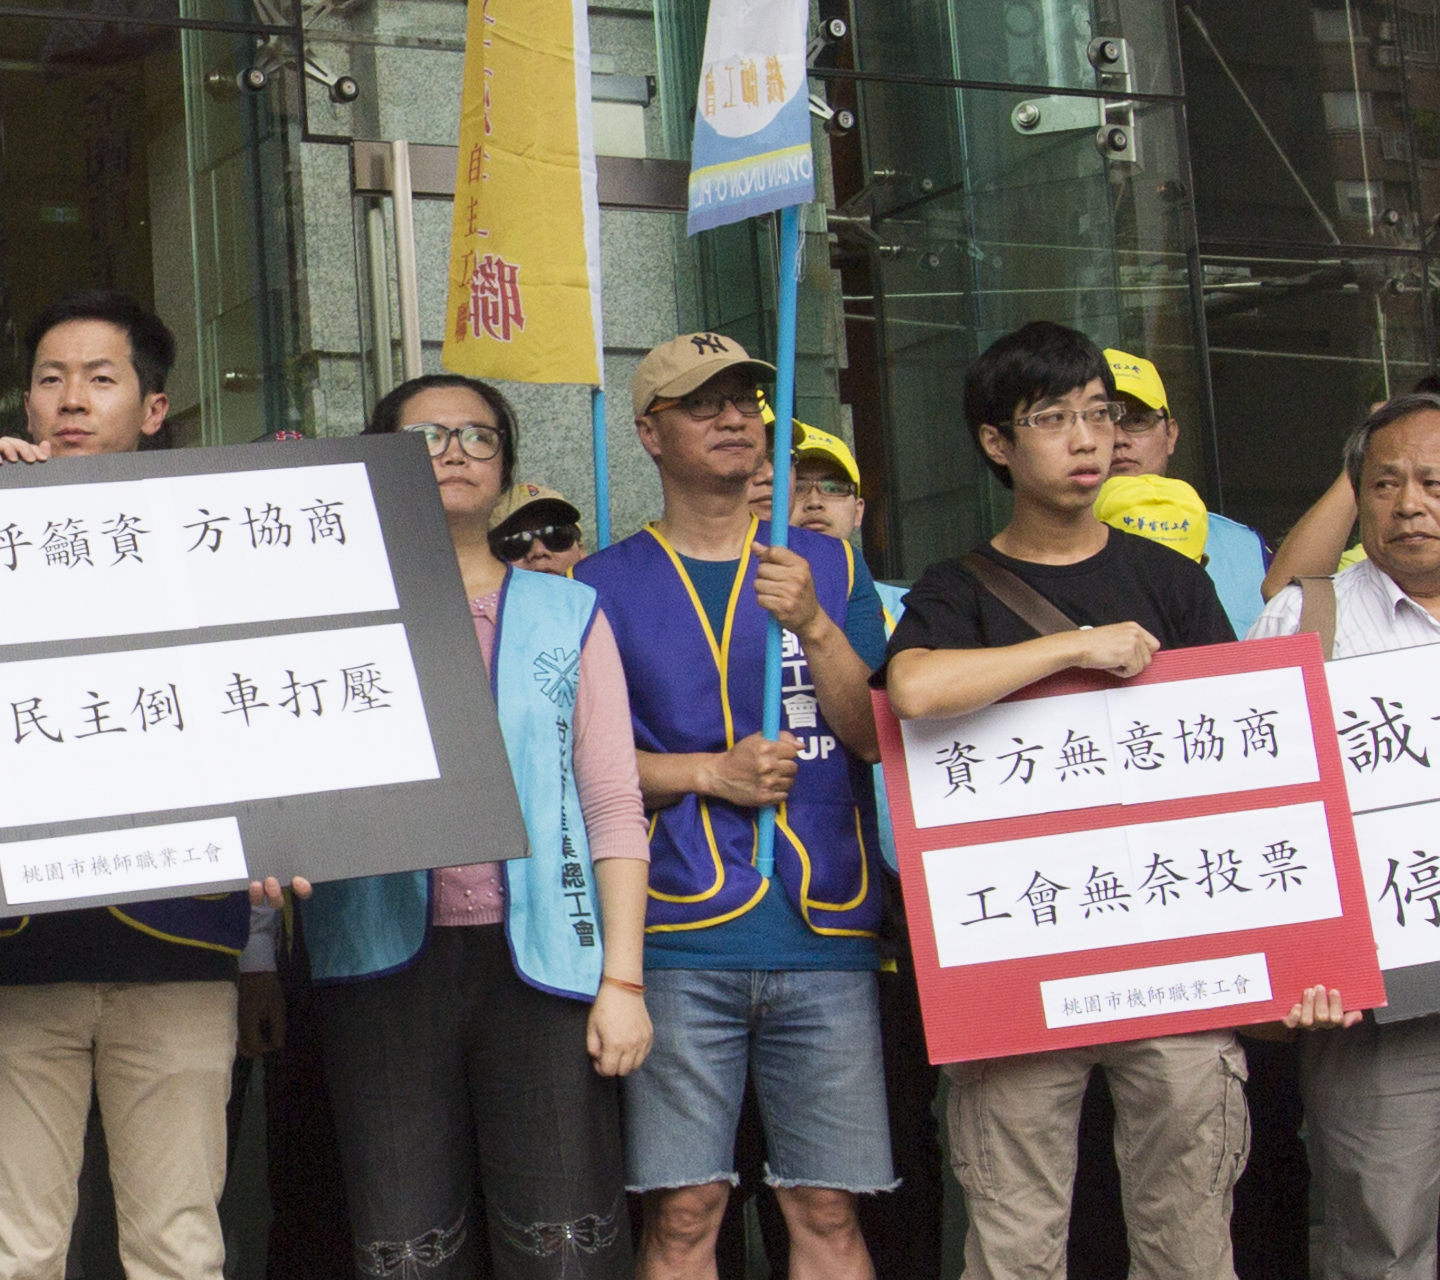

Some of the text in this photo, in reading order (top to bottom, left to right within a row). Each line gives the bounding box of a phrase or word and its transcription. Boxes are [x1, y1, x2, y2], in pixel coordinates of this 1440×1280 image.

[796, 735, 837, 761] UP
[936, 709, 1277, 794] 資方無意協商
[22, 841, 223, 884] 桃園市機師職業工會
[962, 841, 1307, 926] 工會無奈投票
[1062, 973, 1251, 1017] 桃園市機師職業工會
